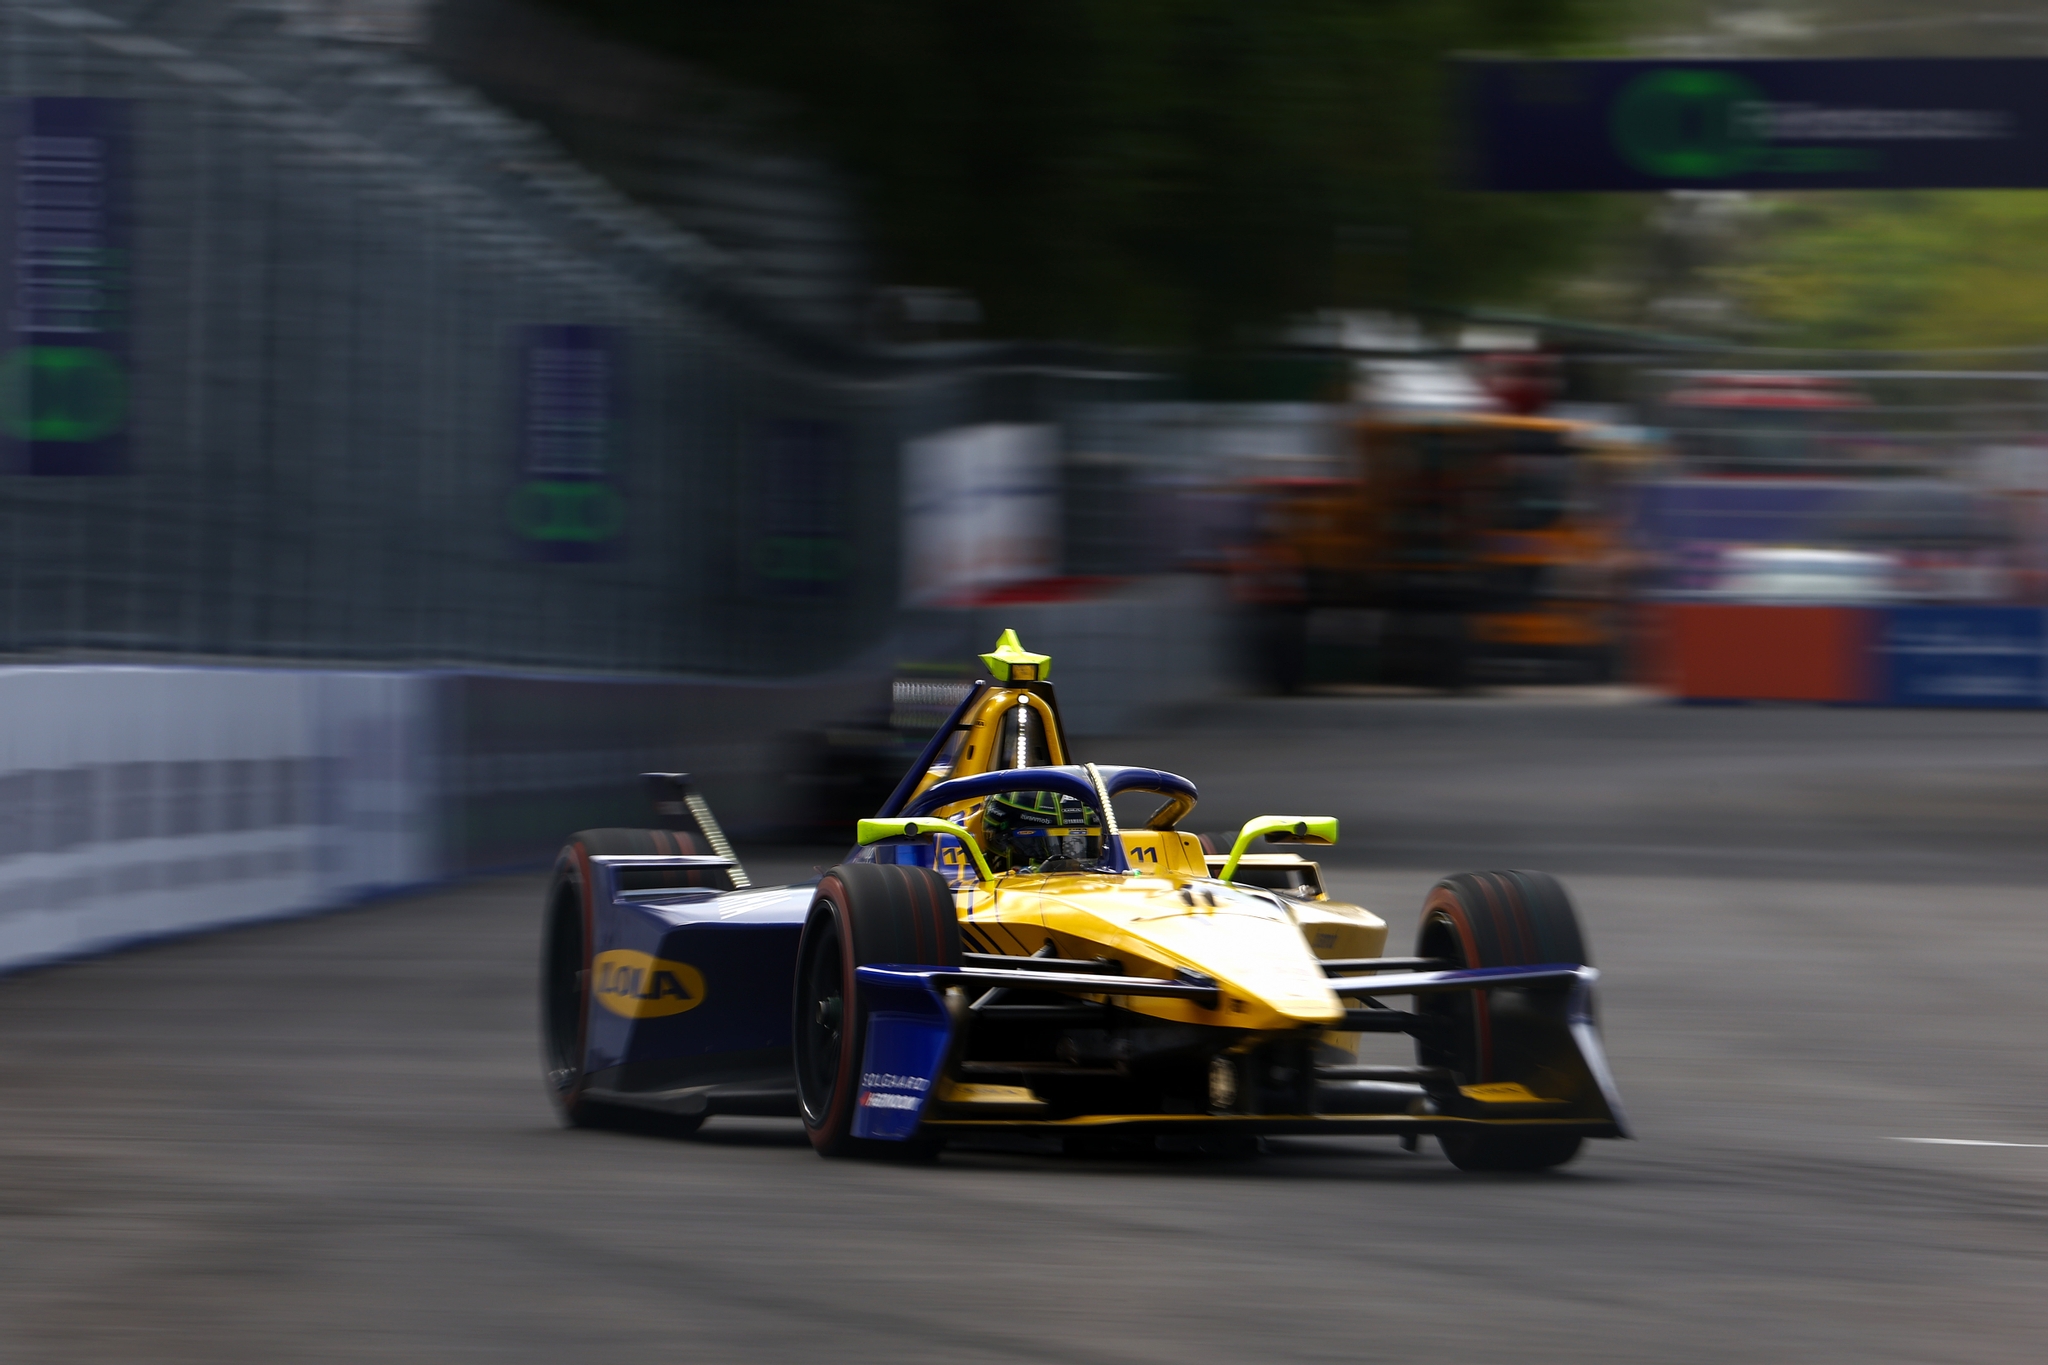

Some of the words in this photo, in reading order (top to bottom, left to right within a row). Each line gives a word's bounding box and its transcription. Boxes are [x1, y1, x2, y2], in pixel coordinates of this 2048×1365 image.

[1130, 847, 1158, 863] 11
[600, 961, 693, 1000] LOLA
[862, 1073, 931, 1091] SOLGAARD
